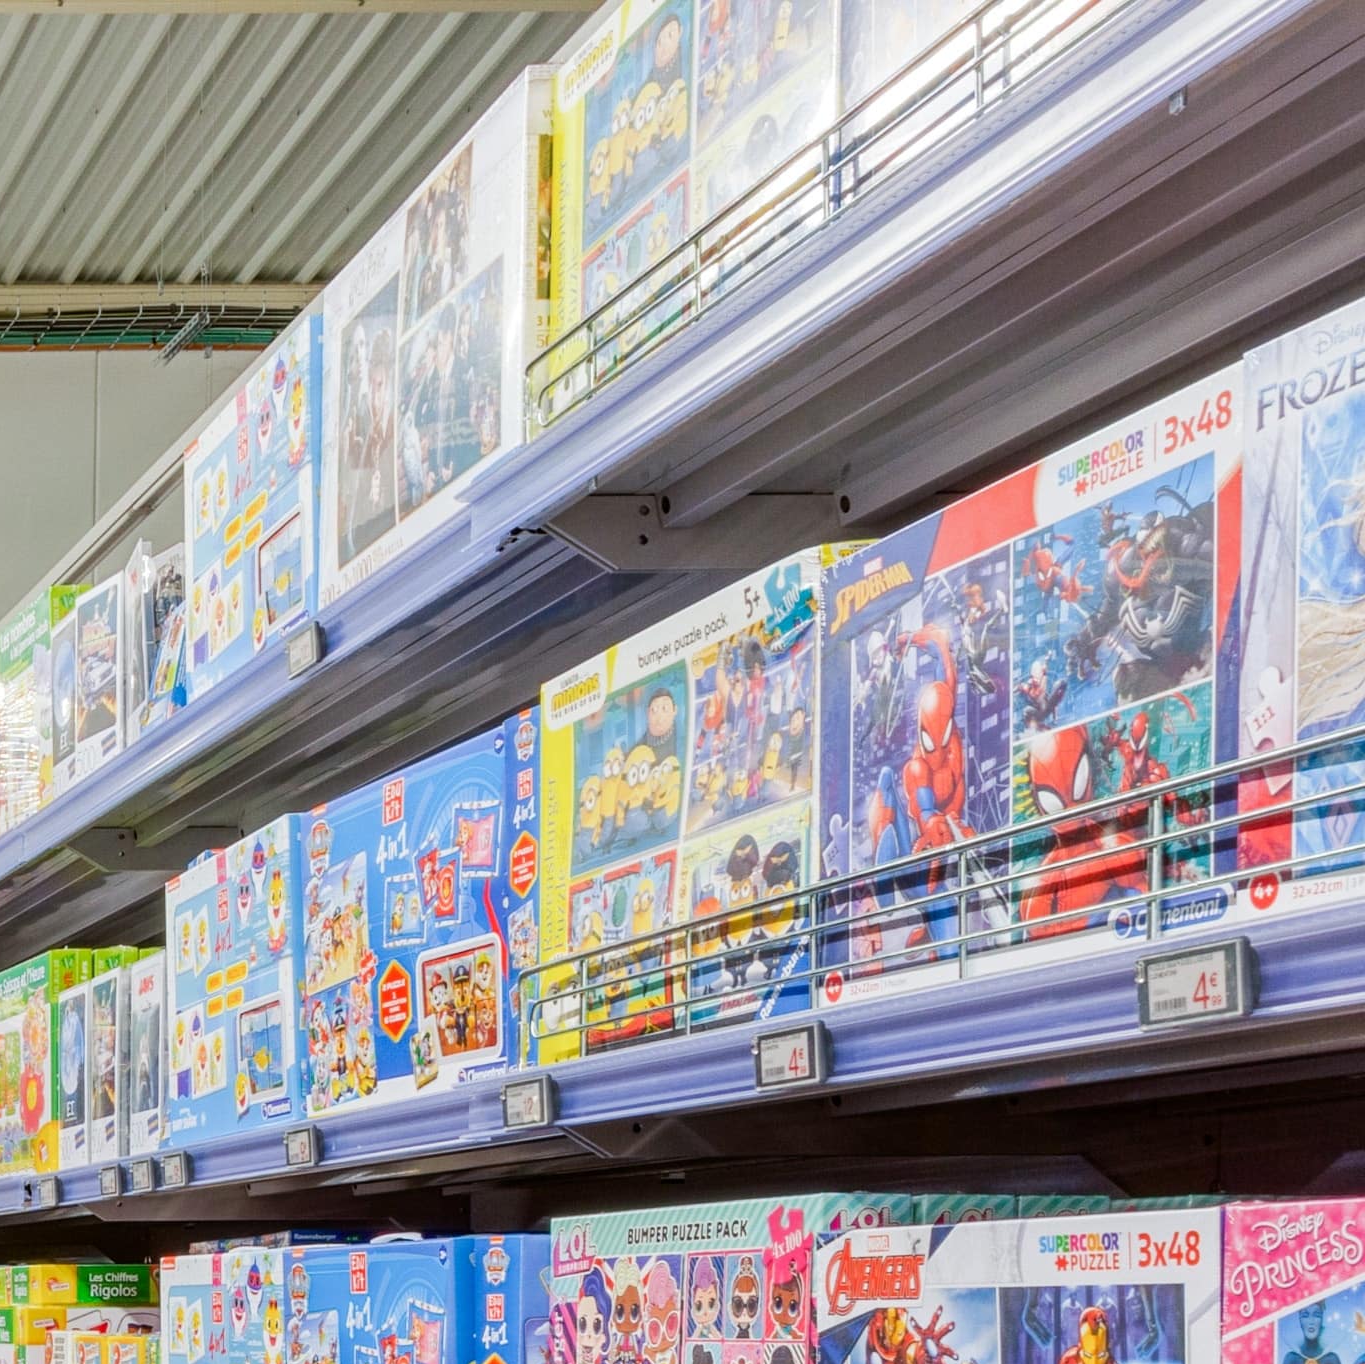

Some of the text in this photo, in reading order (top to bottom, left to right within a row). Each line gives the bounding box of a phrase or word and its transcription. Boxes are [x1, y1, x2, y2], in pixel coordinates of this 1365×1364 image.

[1255, 349, 1365, 432] FROZE
[1162, 389, 1233, 456] 3x48
[1056, 428, 1146, 489] SUPERCOLOR
[1090, 452, 1144, 492] PUZZLE
[743, 586, 761, 619] 5+
[830, 561, 913, 637] SPIDER-MAN
[638, 612, 728, 669] bumper puzzle pack
[551, 672, 600, 711] minions
[1253, 879, 1275, 901] 4+
[1135, 897, 1224, 934] Cmentoni.
[554, 1223, 595, 1263] LOL
[627, 1221, 748, 1245] BUMPER PUZZLE PACK
[771, 1228, 803, 1259] 4x100
[1039, 1232, 1119, 1254] SUPERCOLOR
[1138, 1230, 1201, 1268] 3x48
[89, 1272, 139, 1282] Les Chiffres
[828, 1238, 925, 1316] AVENGERS
[1070, 1254, 1119, 1271] PUZZLE
[1230, 1219, 1363, 1318] PRINCESS
[90, 1283, 137, 1298] Rigolos
